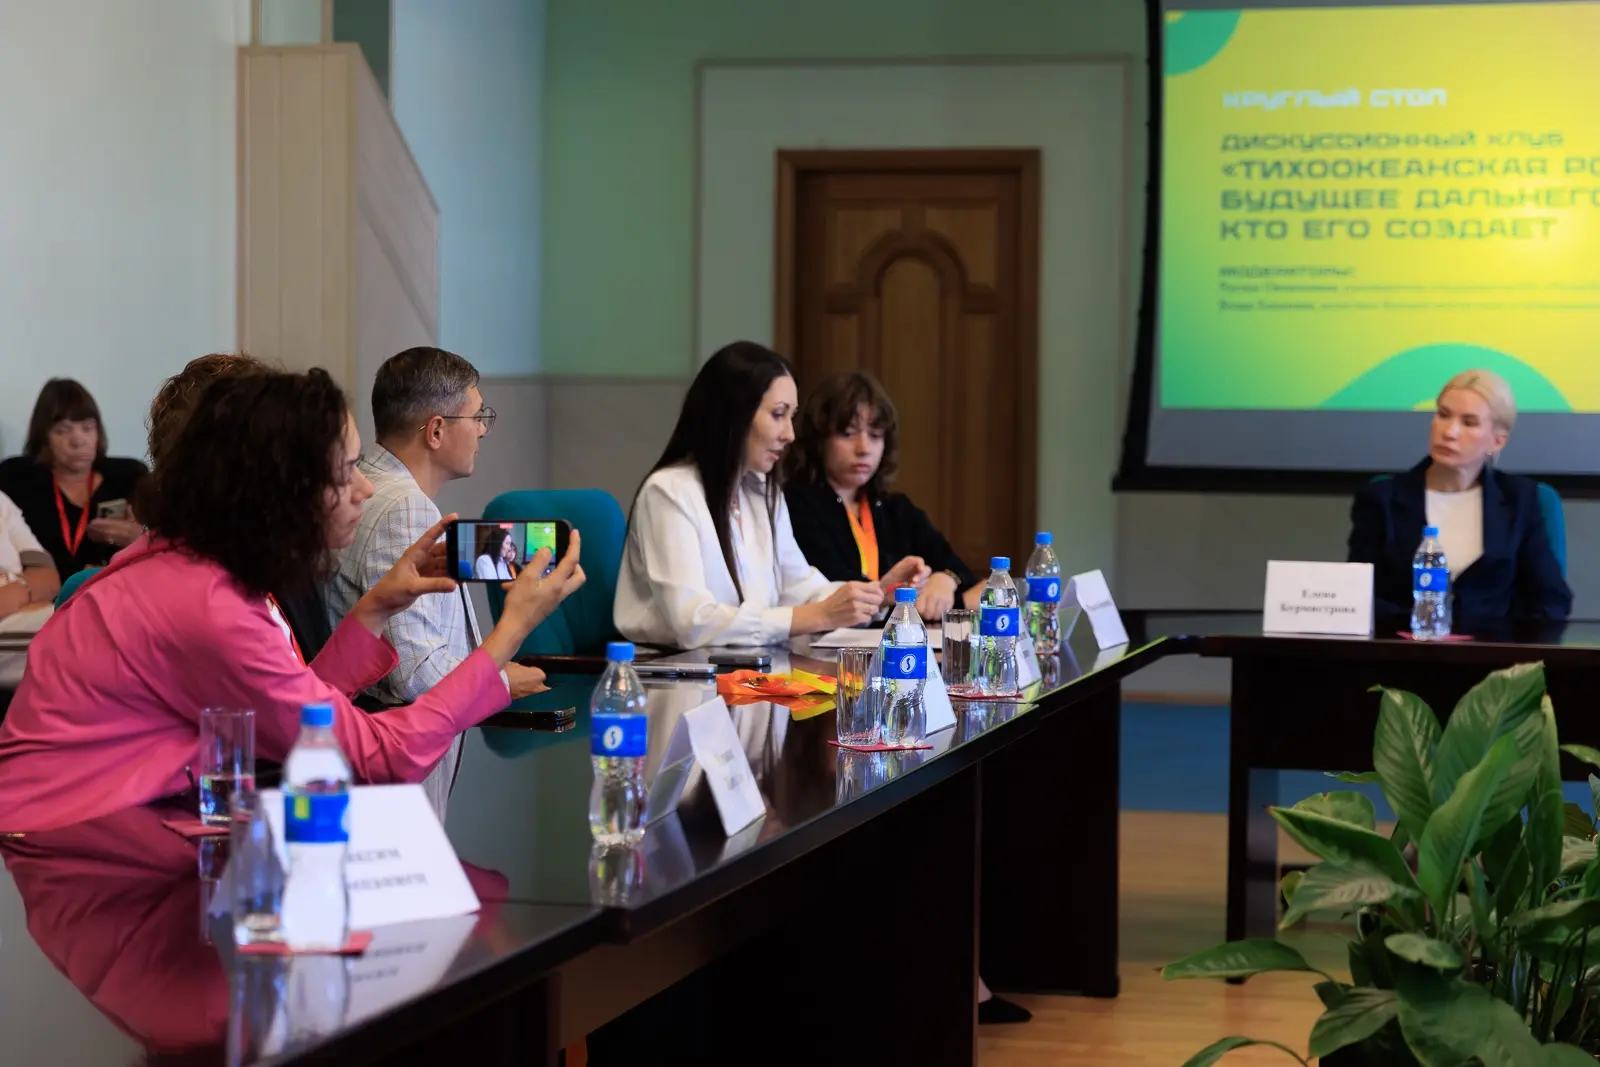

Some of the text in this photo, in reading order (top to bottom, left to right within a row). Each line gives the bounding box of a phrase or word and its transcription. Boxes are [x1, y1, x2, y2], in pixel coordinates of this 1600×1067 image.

[1222, 86, 1447, 110] КРУГЛЫЙ СТОЛ
[1221, 131, 1564, 151] ДИСКУССИОННЫЙ КЛУБ
[1221, 157, 1547, 180] «ТИХООКЕАНСКАЯ
[1220, 189, 1399, 212] БУДУЩЕЕ
[1220, 217, 1558, 241] КТО ЕГО СОЗДАЕТ
